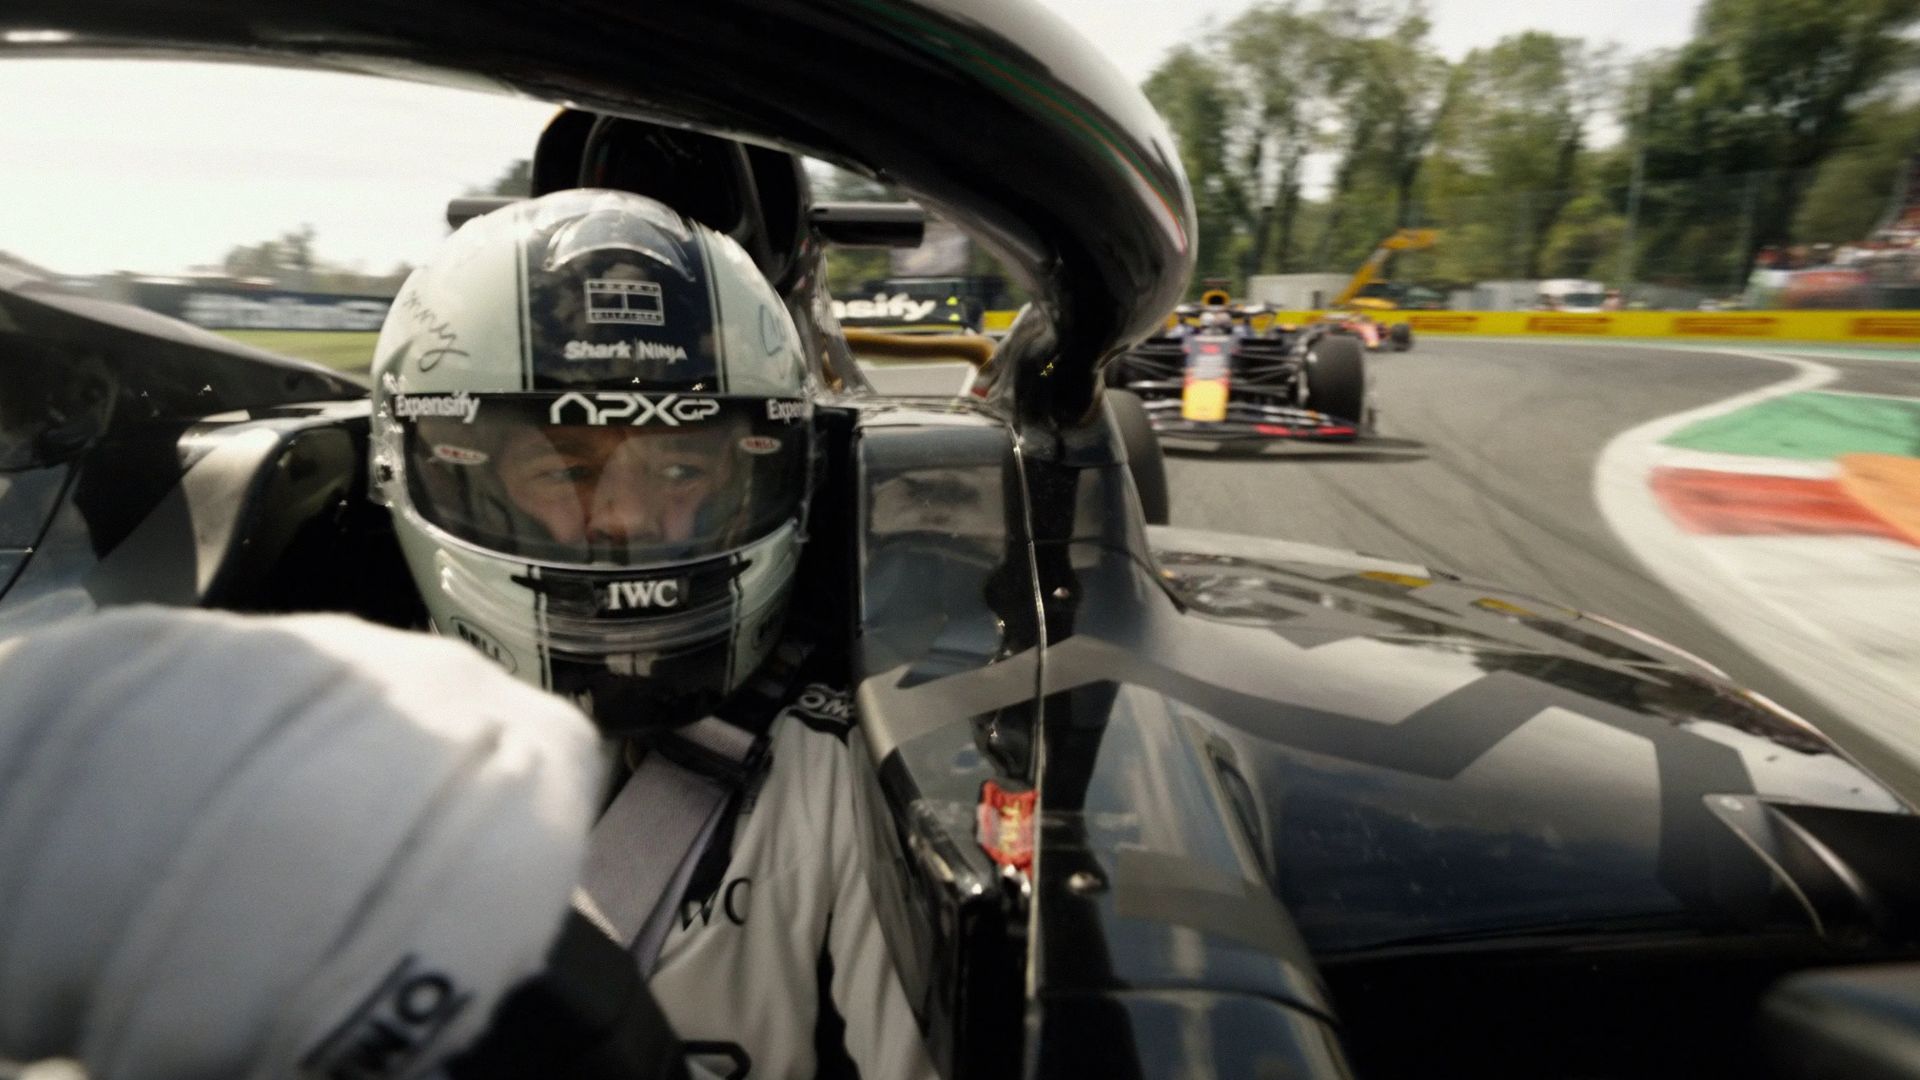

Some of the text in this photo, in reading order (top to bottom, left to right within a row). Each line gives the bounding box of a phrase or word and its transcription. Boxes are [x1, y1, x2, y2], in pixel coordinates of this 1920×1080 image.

[563, 340, 631, 360] Shark
[395, 391, 480, 424] Expensify
[608, 579, 678, 610] IWC
